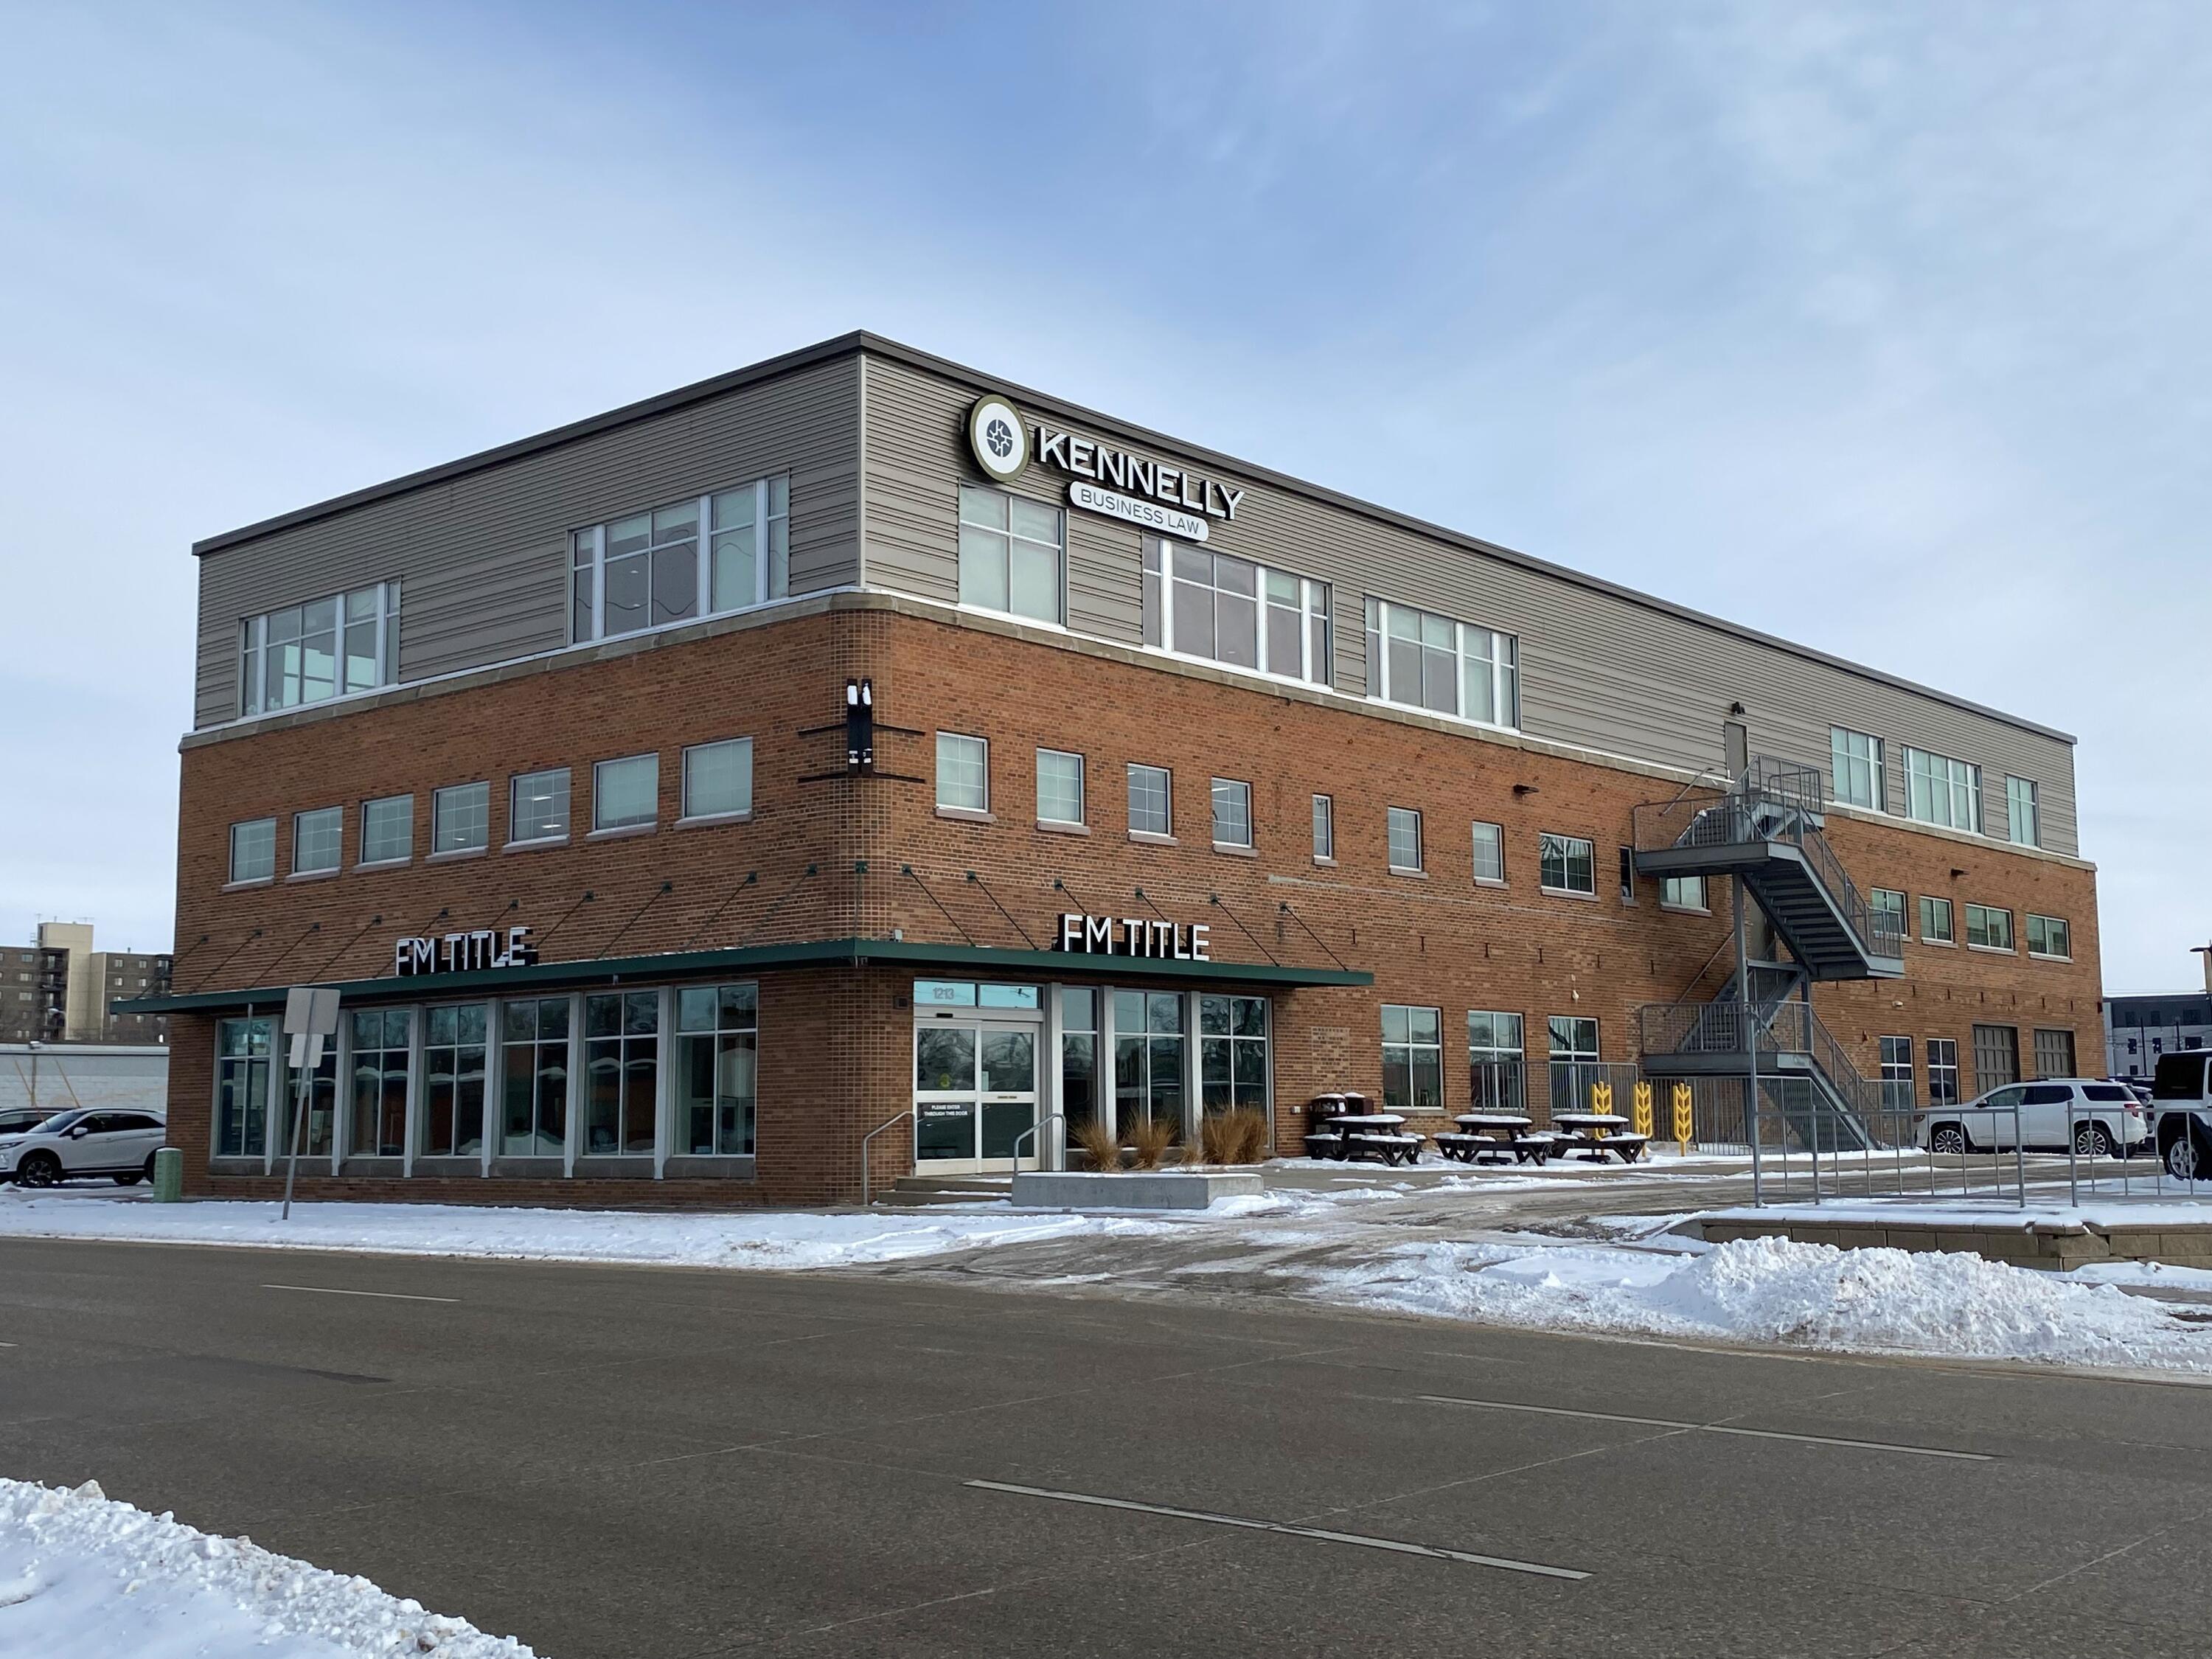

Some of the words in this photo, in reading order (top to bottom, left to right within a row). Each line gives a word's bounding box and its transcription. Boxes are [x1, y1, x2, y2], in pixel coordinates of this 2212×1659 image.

[1037, 426, 1245, 520] KENNELLY
[1080, 489, 1164, 524] BUSINESS
[1167, 513, 1200, 535] LAW
[396, 937, 436, 975] FM
[445, 926, 528, 972] TITLE
[1064, 914, 1112, 955] FM
[1123, 919, 1210, 961] TITLE
[933, 987, 954, 1000] 1213
